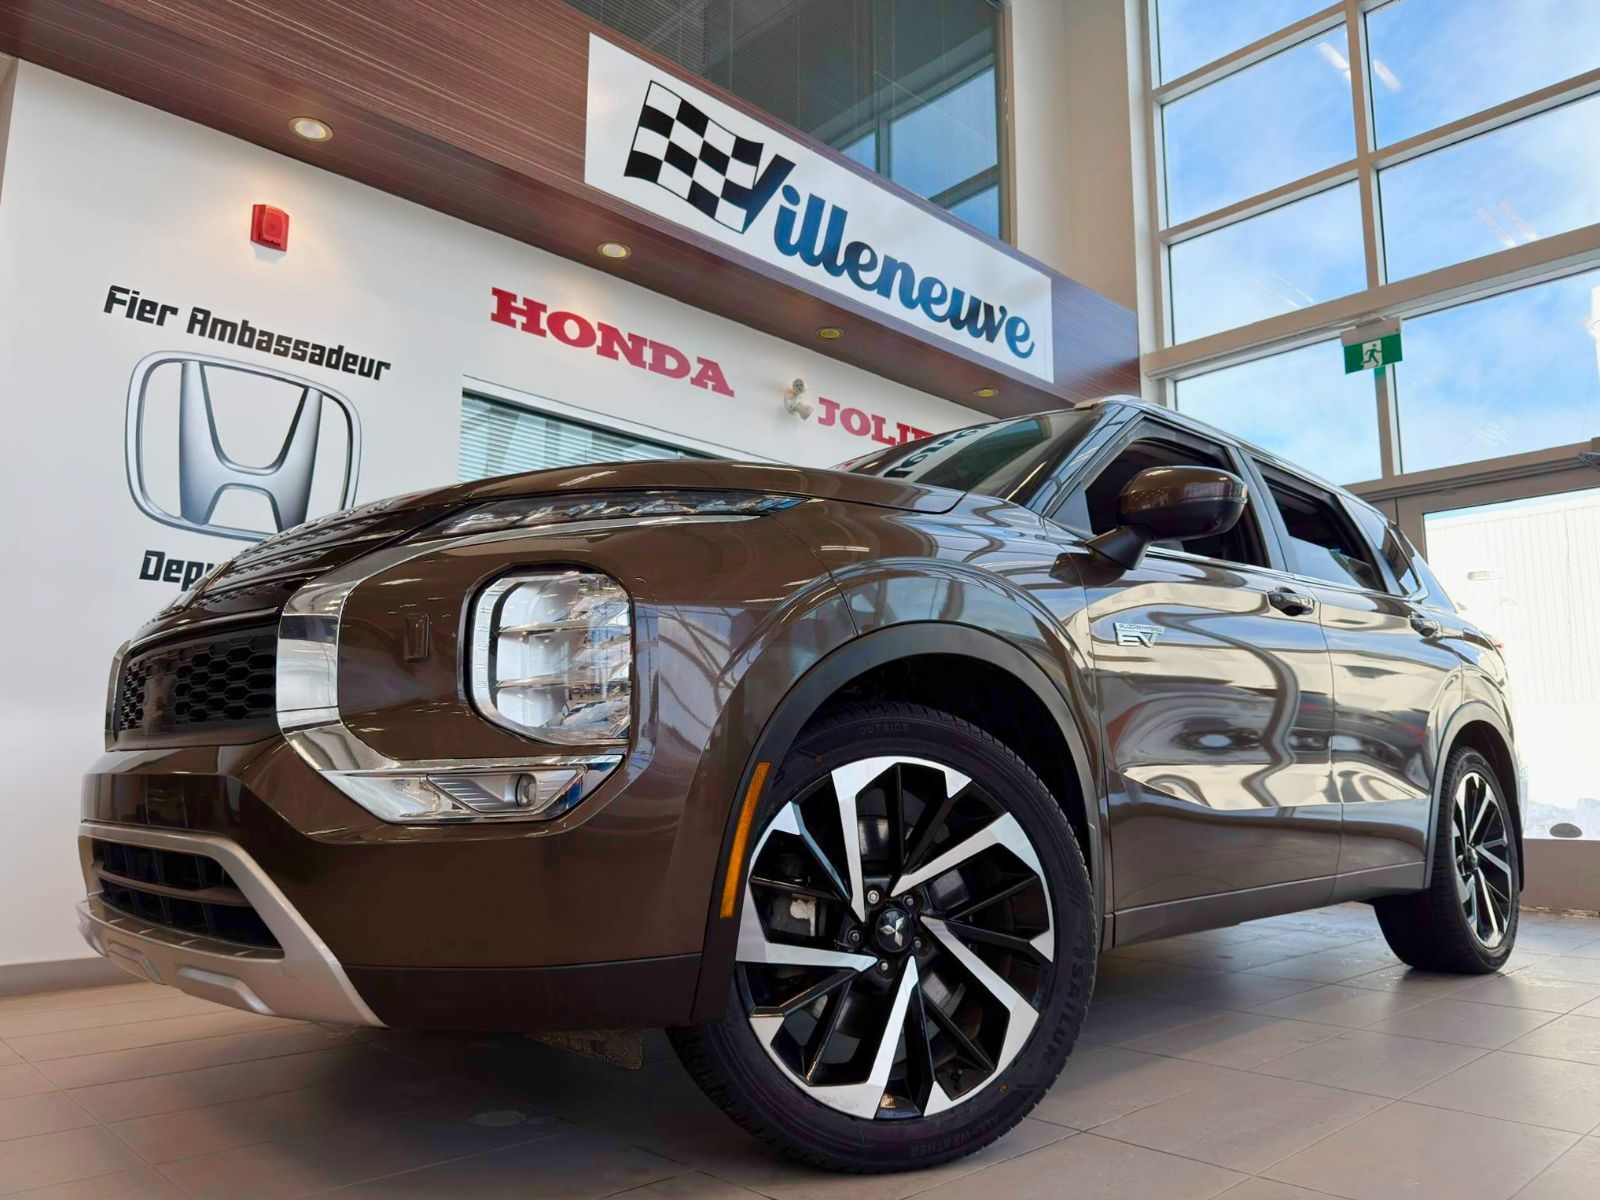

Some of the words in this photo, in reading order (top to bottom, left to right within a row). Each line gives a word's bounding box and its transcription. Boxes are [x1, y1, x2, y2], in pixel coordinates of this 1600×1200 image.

[720, 154, 1036, 359] Villeneuve
[103, 284, 179, 327] Fier
[186, 306, 392, 381] Ambassadeur
[490, 287, 734, 397] HONDA
[139, 549, 214, 592] Dep
[858, 722, 910, 736] OUTSIDE
